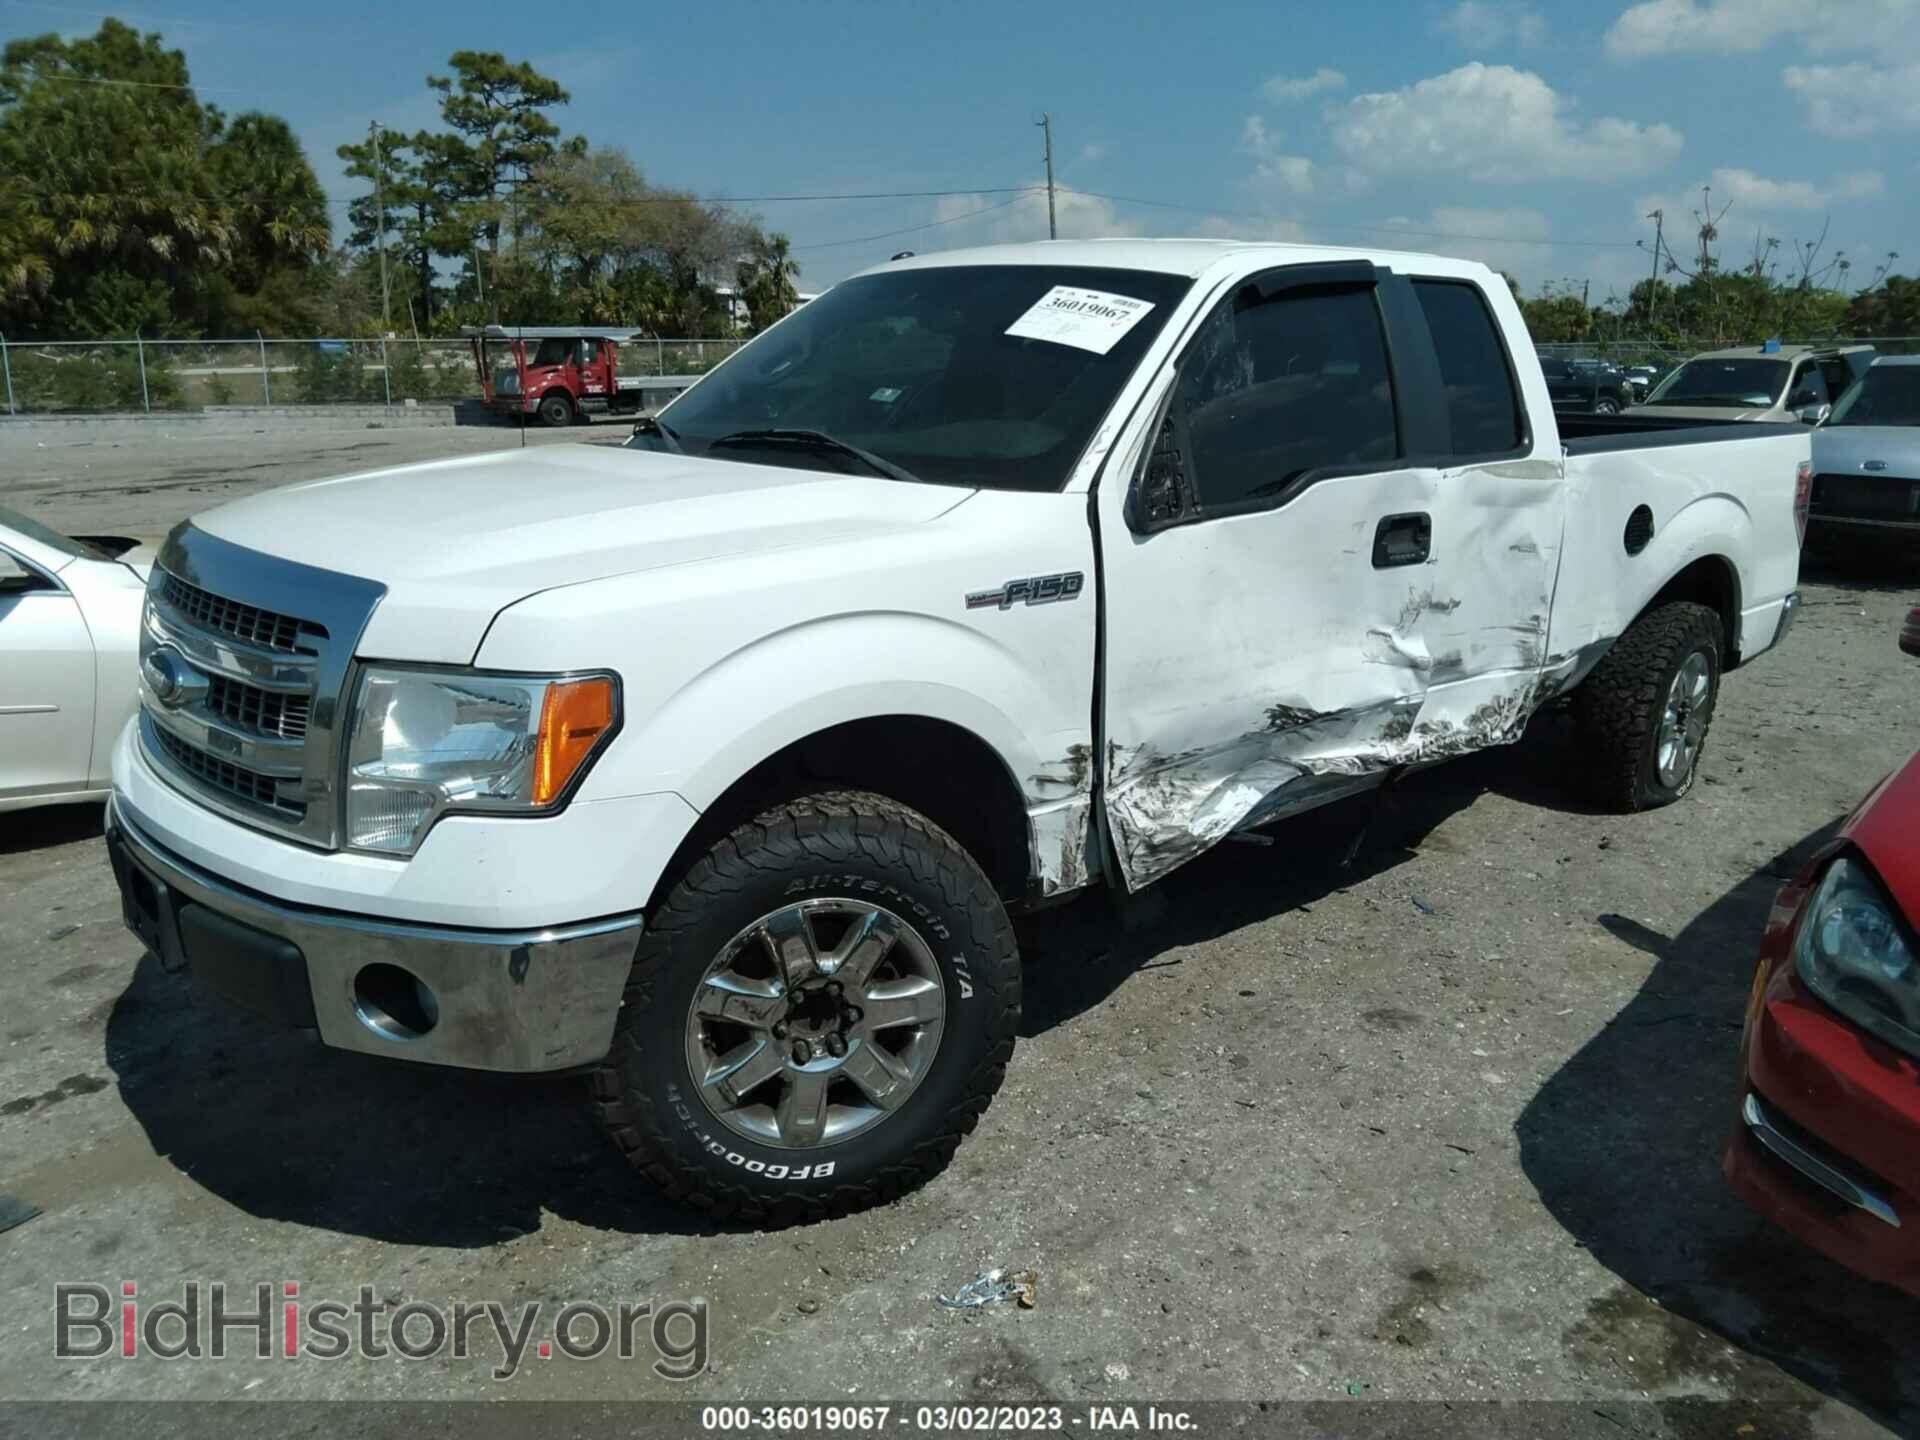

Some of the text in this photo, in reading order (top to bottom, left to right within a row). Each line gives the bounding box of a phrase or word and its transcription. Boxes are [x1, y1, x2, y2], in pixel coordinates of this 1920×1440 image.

[1045, 297, 1131, 321] 36019067
[998, 570, 1084, 611] F-150
[952, 951, 974, 1000] T/A
